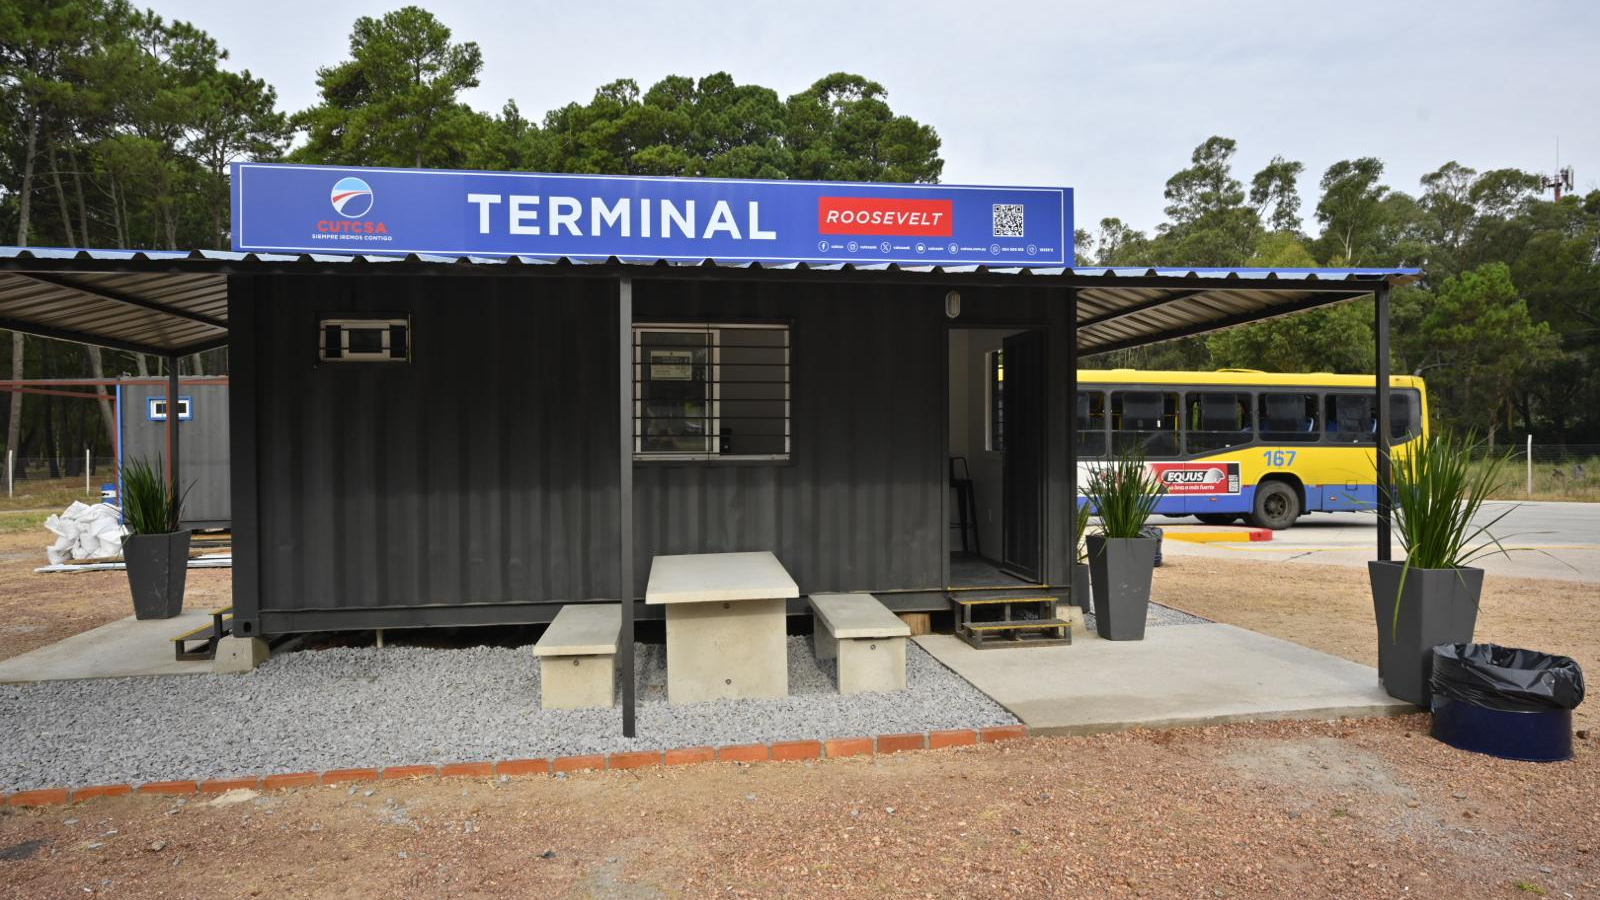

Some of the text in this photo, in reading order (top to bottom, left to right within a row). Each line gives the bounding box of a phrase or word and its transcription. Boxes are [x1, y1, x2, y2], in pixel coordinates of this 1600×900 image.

[467, 193, 777, 241] TERMINAL
[826, 210, 943, 226] ROOSEVELT
[316, 220, 389, 234] CUTCSA
[1264, 451, 1297, 467] 167
[1167, 471, 1203, 482] EQUUS
